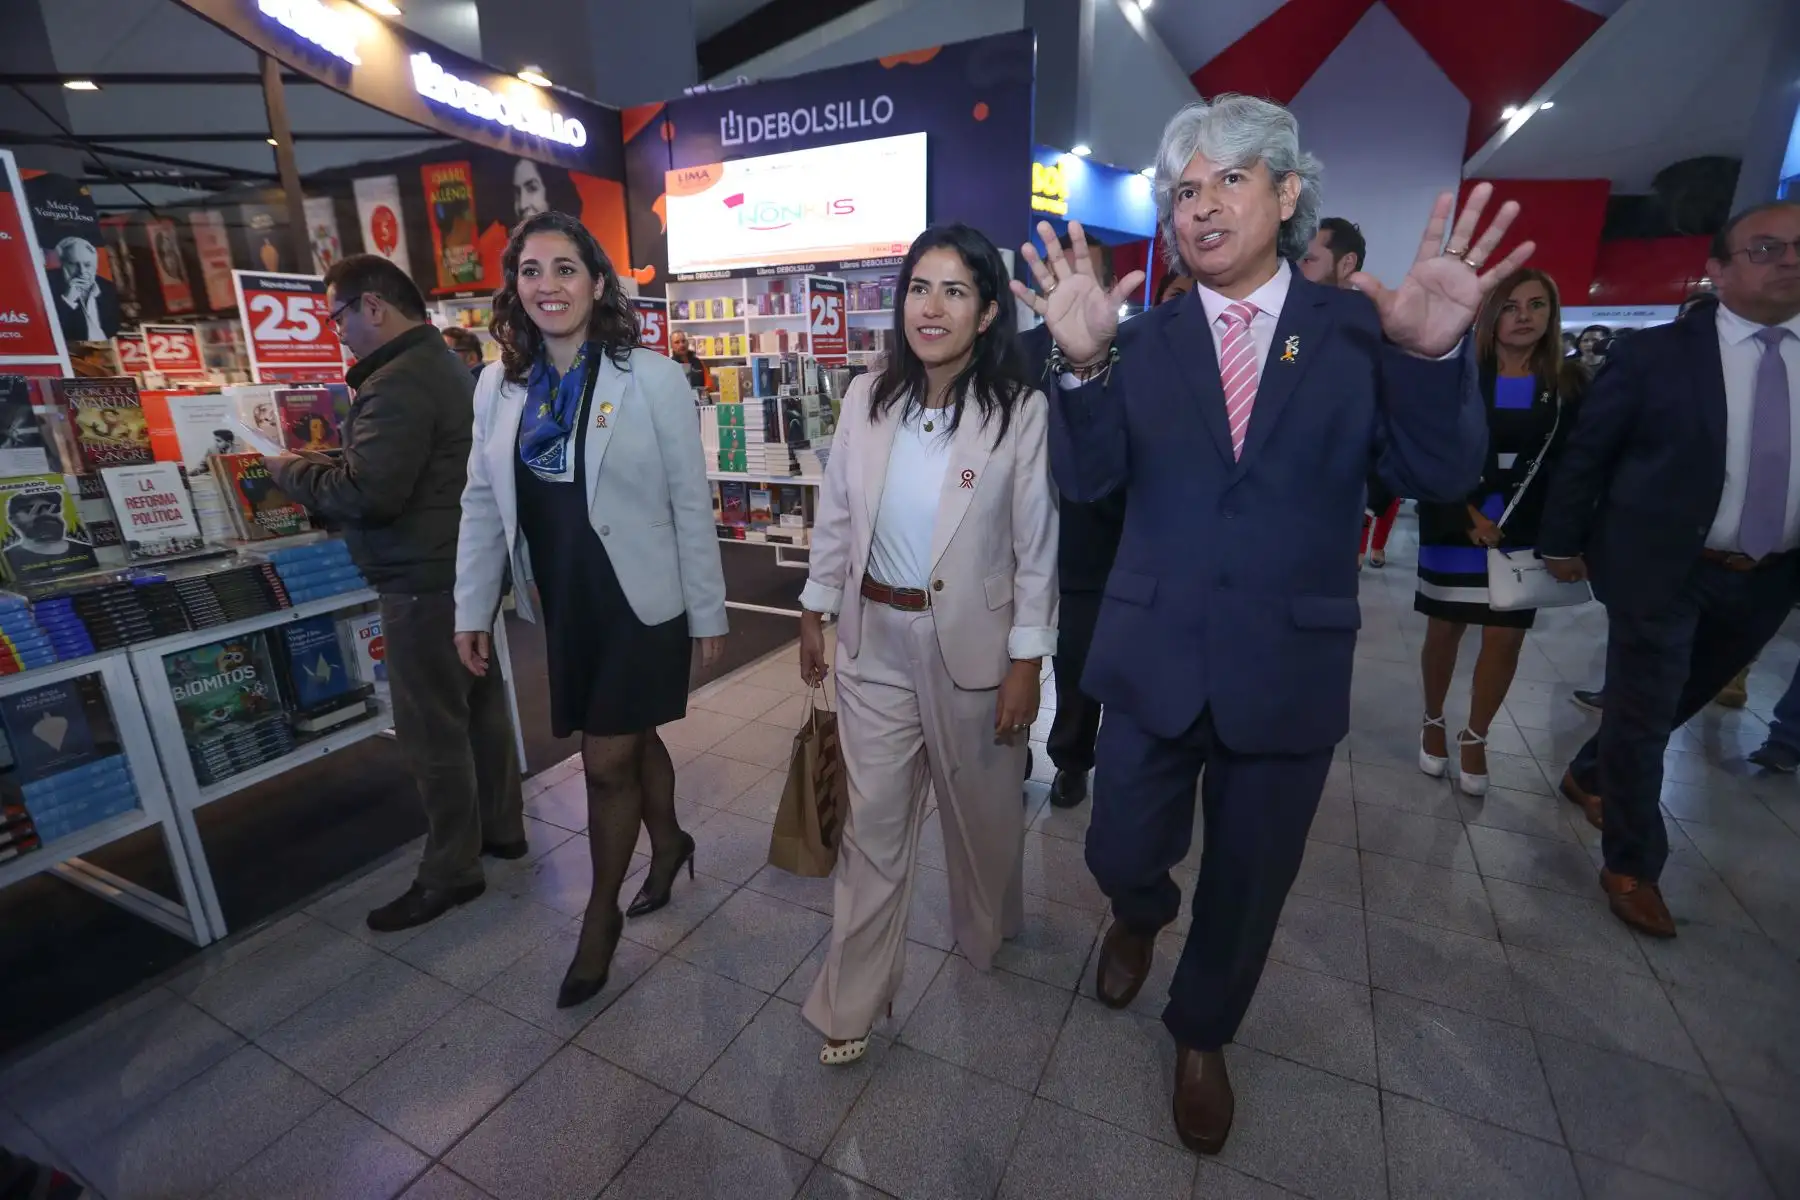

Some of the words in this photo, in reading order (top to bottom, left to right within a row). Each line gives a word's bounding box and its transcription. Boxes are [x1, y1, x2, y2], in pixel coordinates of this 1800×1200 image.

[746, 95, 894, 143] DEBOLSILLO
[46, 199, 80, 212] Mario
[34, 207, 67, 220] Vargas
[68, 210, 95, 223] Llosa
[776, 263, 816, 275] DEBOLSILLO
[68, 395, 140, 410] MARTIN
[138, 479, 156, 492] LA
[125, 492, 179, 510] REFORMA
[172, 665, 257, 701] BIOMITOS
